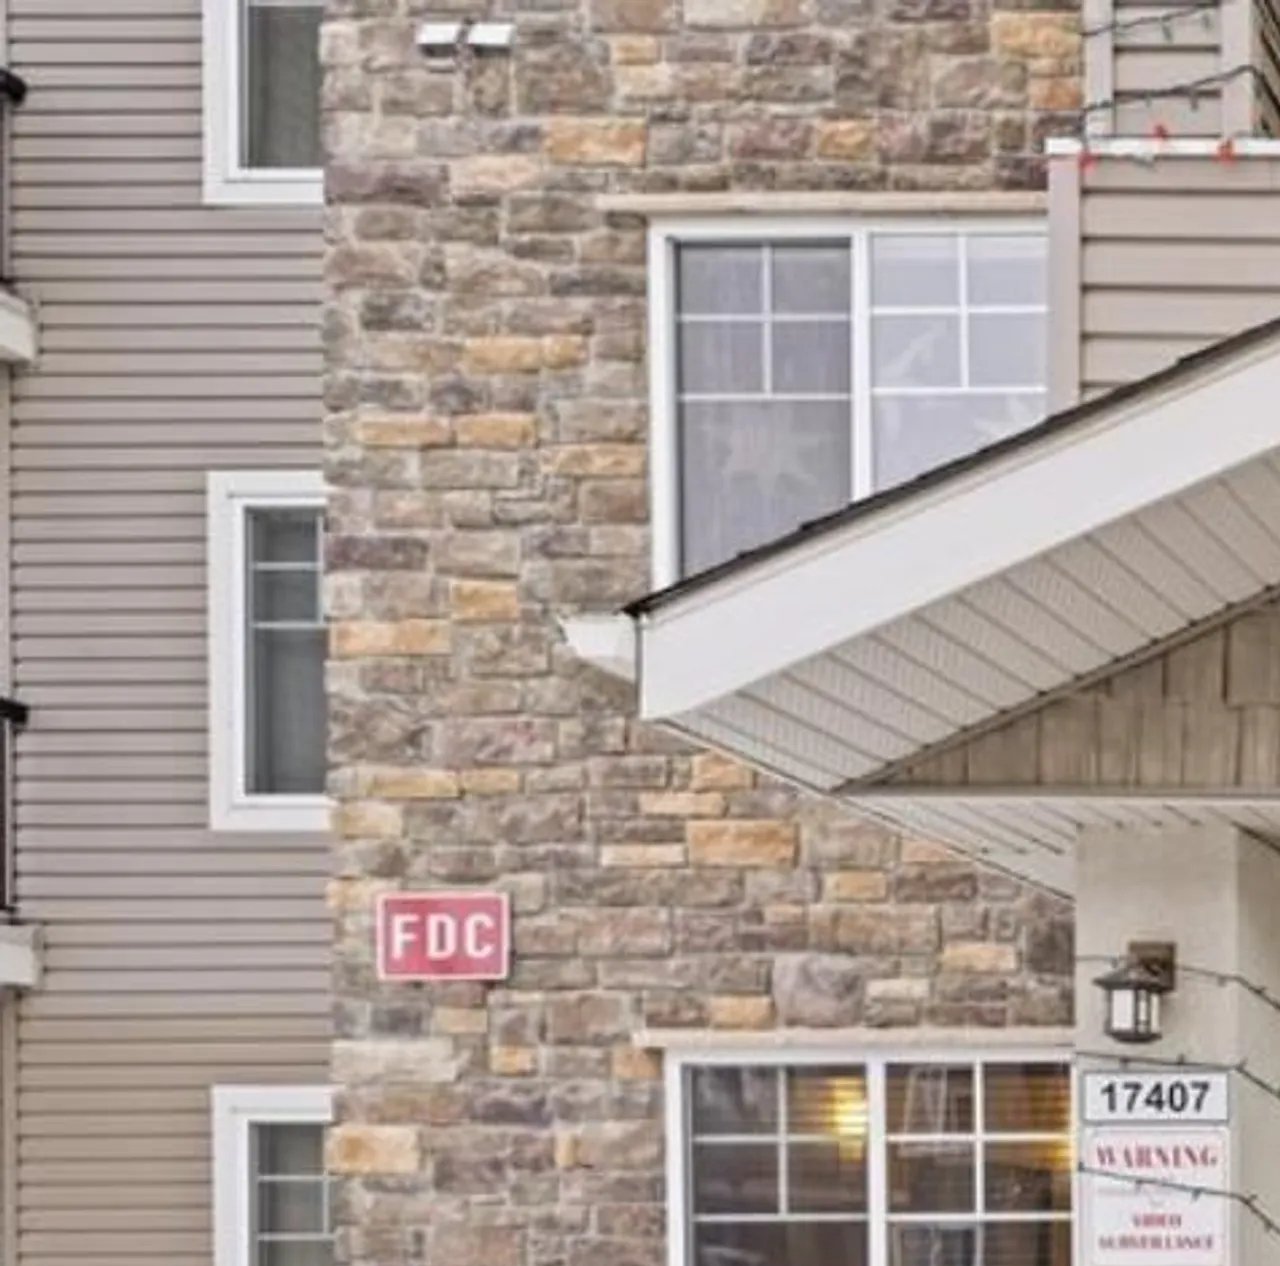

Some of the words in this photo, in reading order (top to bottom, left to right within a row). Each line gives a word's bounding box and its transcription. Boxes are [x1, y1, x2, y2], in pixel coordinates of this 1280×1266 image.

[391, 913, 496, 960] FDC
[1101, 1080, 1210, 1113] 17407
[1096, 1145, 1218, 1168] WARNING
[1132, 1213, 1182, 1228] VIDEO
